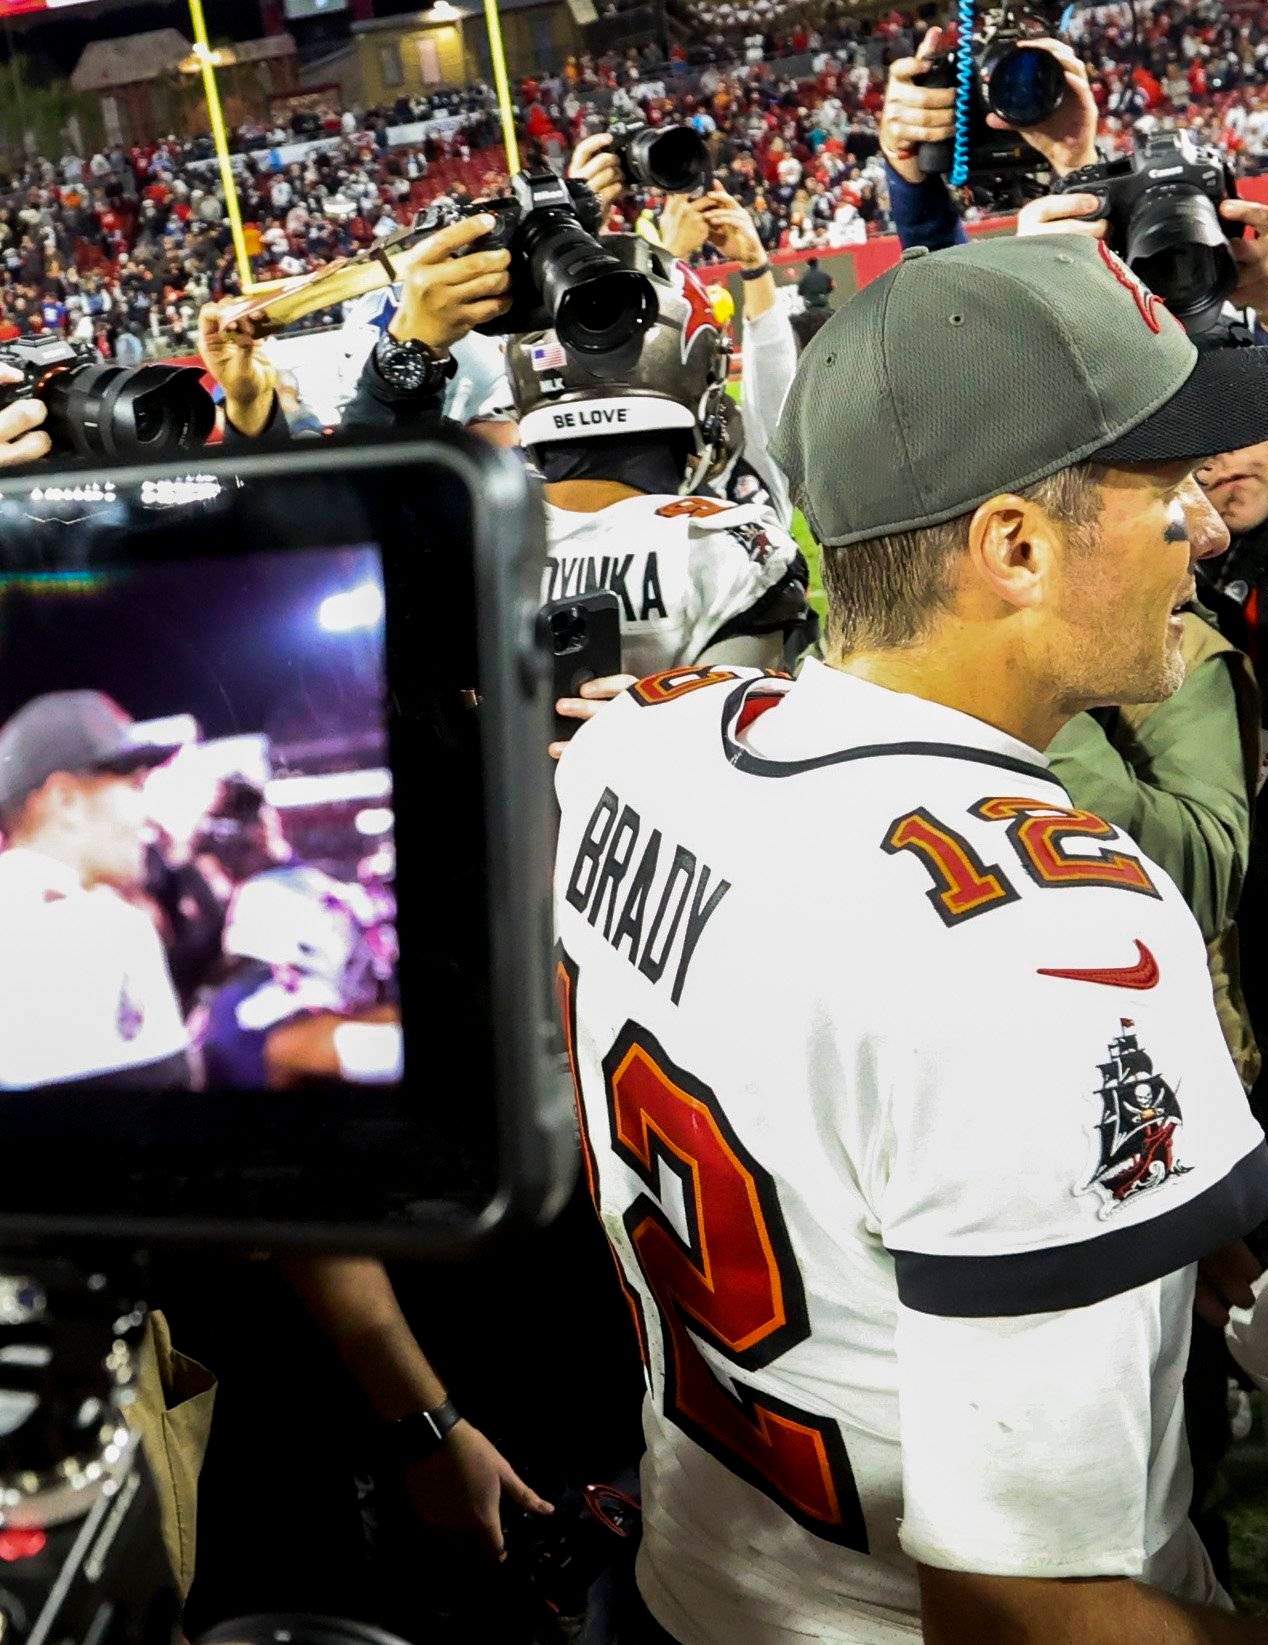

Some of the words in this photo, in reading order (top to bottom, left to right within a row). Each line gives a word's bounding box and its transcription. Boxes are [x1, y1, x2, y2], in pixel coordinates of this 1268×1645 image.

[553, 413, 576, 429] BE
[579, 408, 628, 426] LOVE
[565, 786, 732, 1007] BRADY
[879, 796, 1164, 928] 12
[553, 937, 870, 1555] 2
